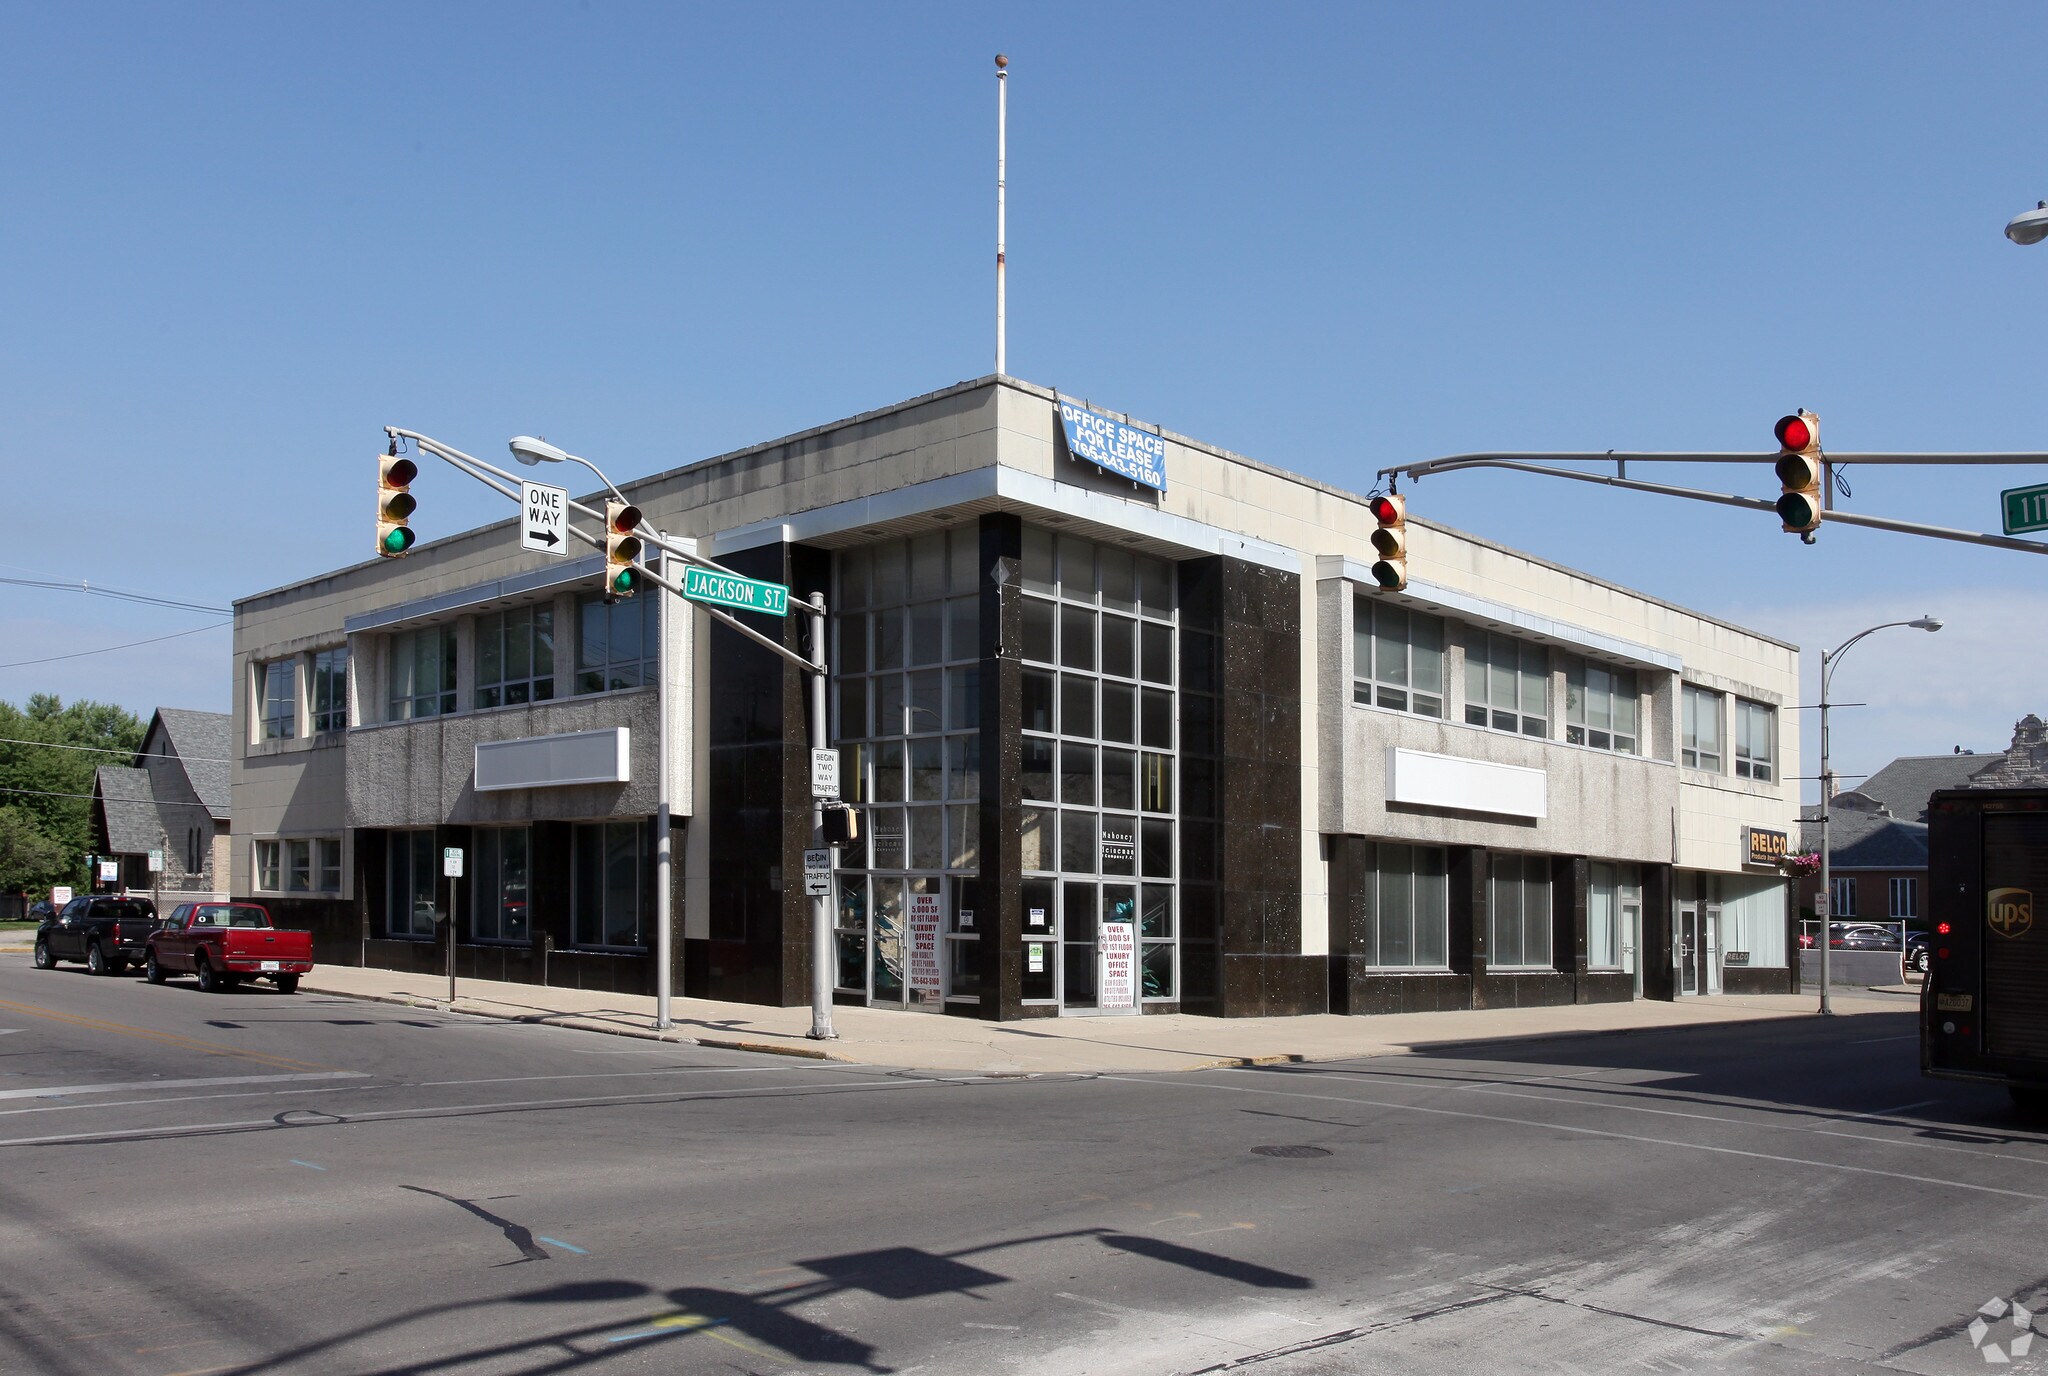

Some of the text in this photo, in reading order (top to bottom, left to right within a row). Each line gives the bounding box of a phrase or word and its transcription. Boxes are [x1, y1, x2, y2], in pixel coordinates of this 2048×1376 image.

[1062, 405, 1163, 456] OFFICE SPACE
[1076, 425, 1153, 469] FOR LEASE
[1072, 438, 1161, 486] 765-643-5160
[530, 489, 560, 509] ONE
[529, 507, 561, 526] WAY
[690, 574, 782, 609] JACKSON ST.
[816, 753, 835, 762] BEGIN
[817, 763, 833, 772] TWO
[817, 773, 833, 782] WAY
[813, 784, 839, 793] TRAFFIC
[1102, 830, 1133, 843] Mahoney
[1751, 832, 1787, 856] RELCO
[806, 854, 827, 862] BEGIN
[1751, 852, 1767, 861] Products
[804, 872, 830, 880] TRAFFIC
[916, 896, 933, 905] OVER
[930, 905, 939, 914] SF
[910, 914, 940, 923] OF 1ST FLOOR
[1990, 903, 2030, 931] ups
[914, 924, 937, 932] LUXURY
[1107, 925, 1125, 934] OVER
[915, 933, 935, 941] OFFICE
[1122, 934, 1131, 942] SF
[916, 942, 935, 951] SPACE
[1109, 943, 1118, 951] 1ST
[1118, 943, 1133, 951] FLOOR
[1106, 952, 1130, 960] LUXURY
[1726, 952, 1749, 961] RELCO
[1108, 961, 1129, 969] OFFICE
[1108, 970, 1128, 978] SPACE
[911, 976, 940, 986] 765-643-5160
